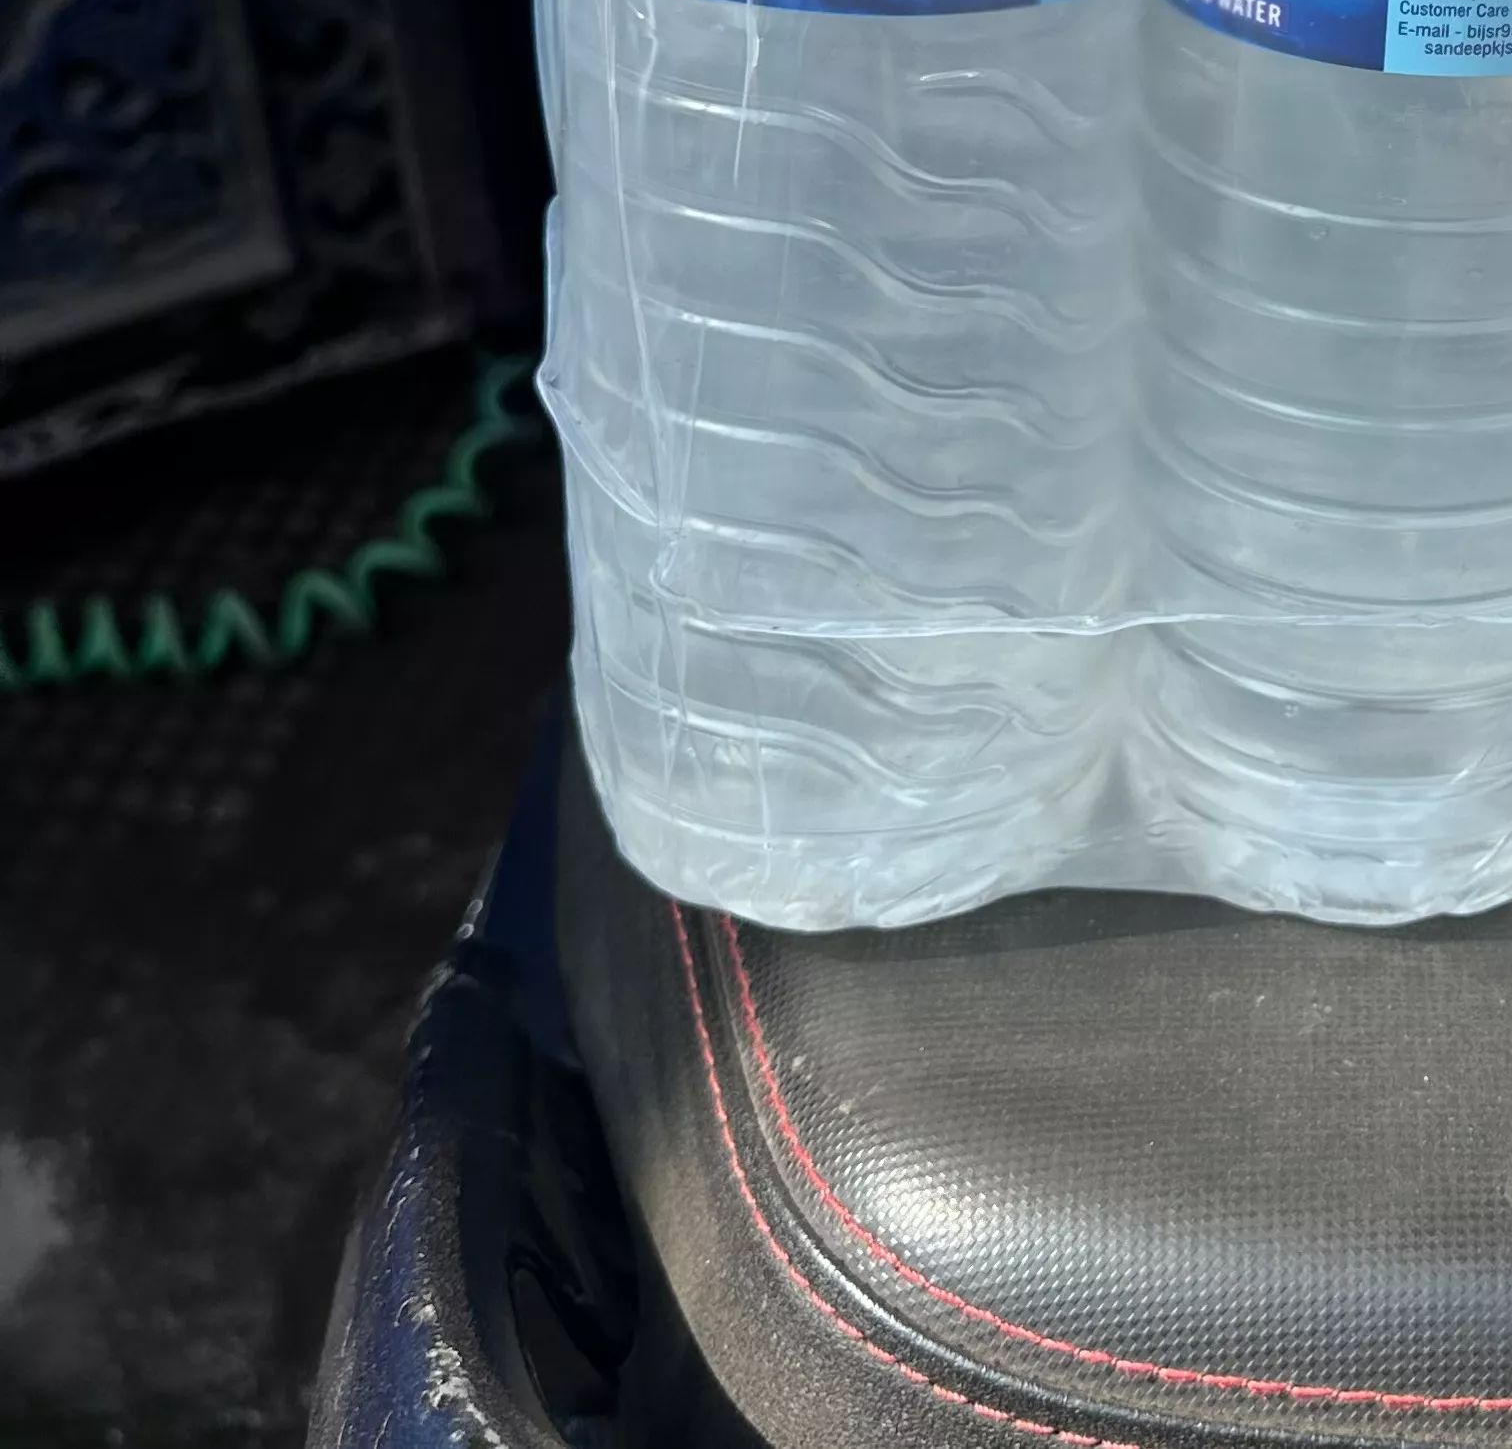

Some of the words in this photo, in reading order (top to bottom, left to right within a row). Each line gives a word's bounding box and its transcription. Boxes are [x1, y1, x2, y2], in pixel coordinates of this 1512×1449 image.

[1400, 0, 1472, 18] Customer
[1477, 3, 1509, 18] Care
[1398, 21, 1450, 38] E-mail
